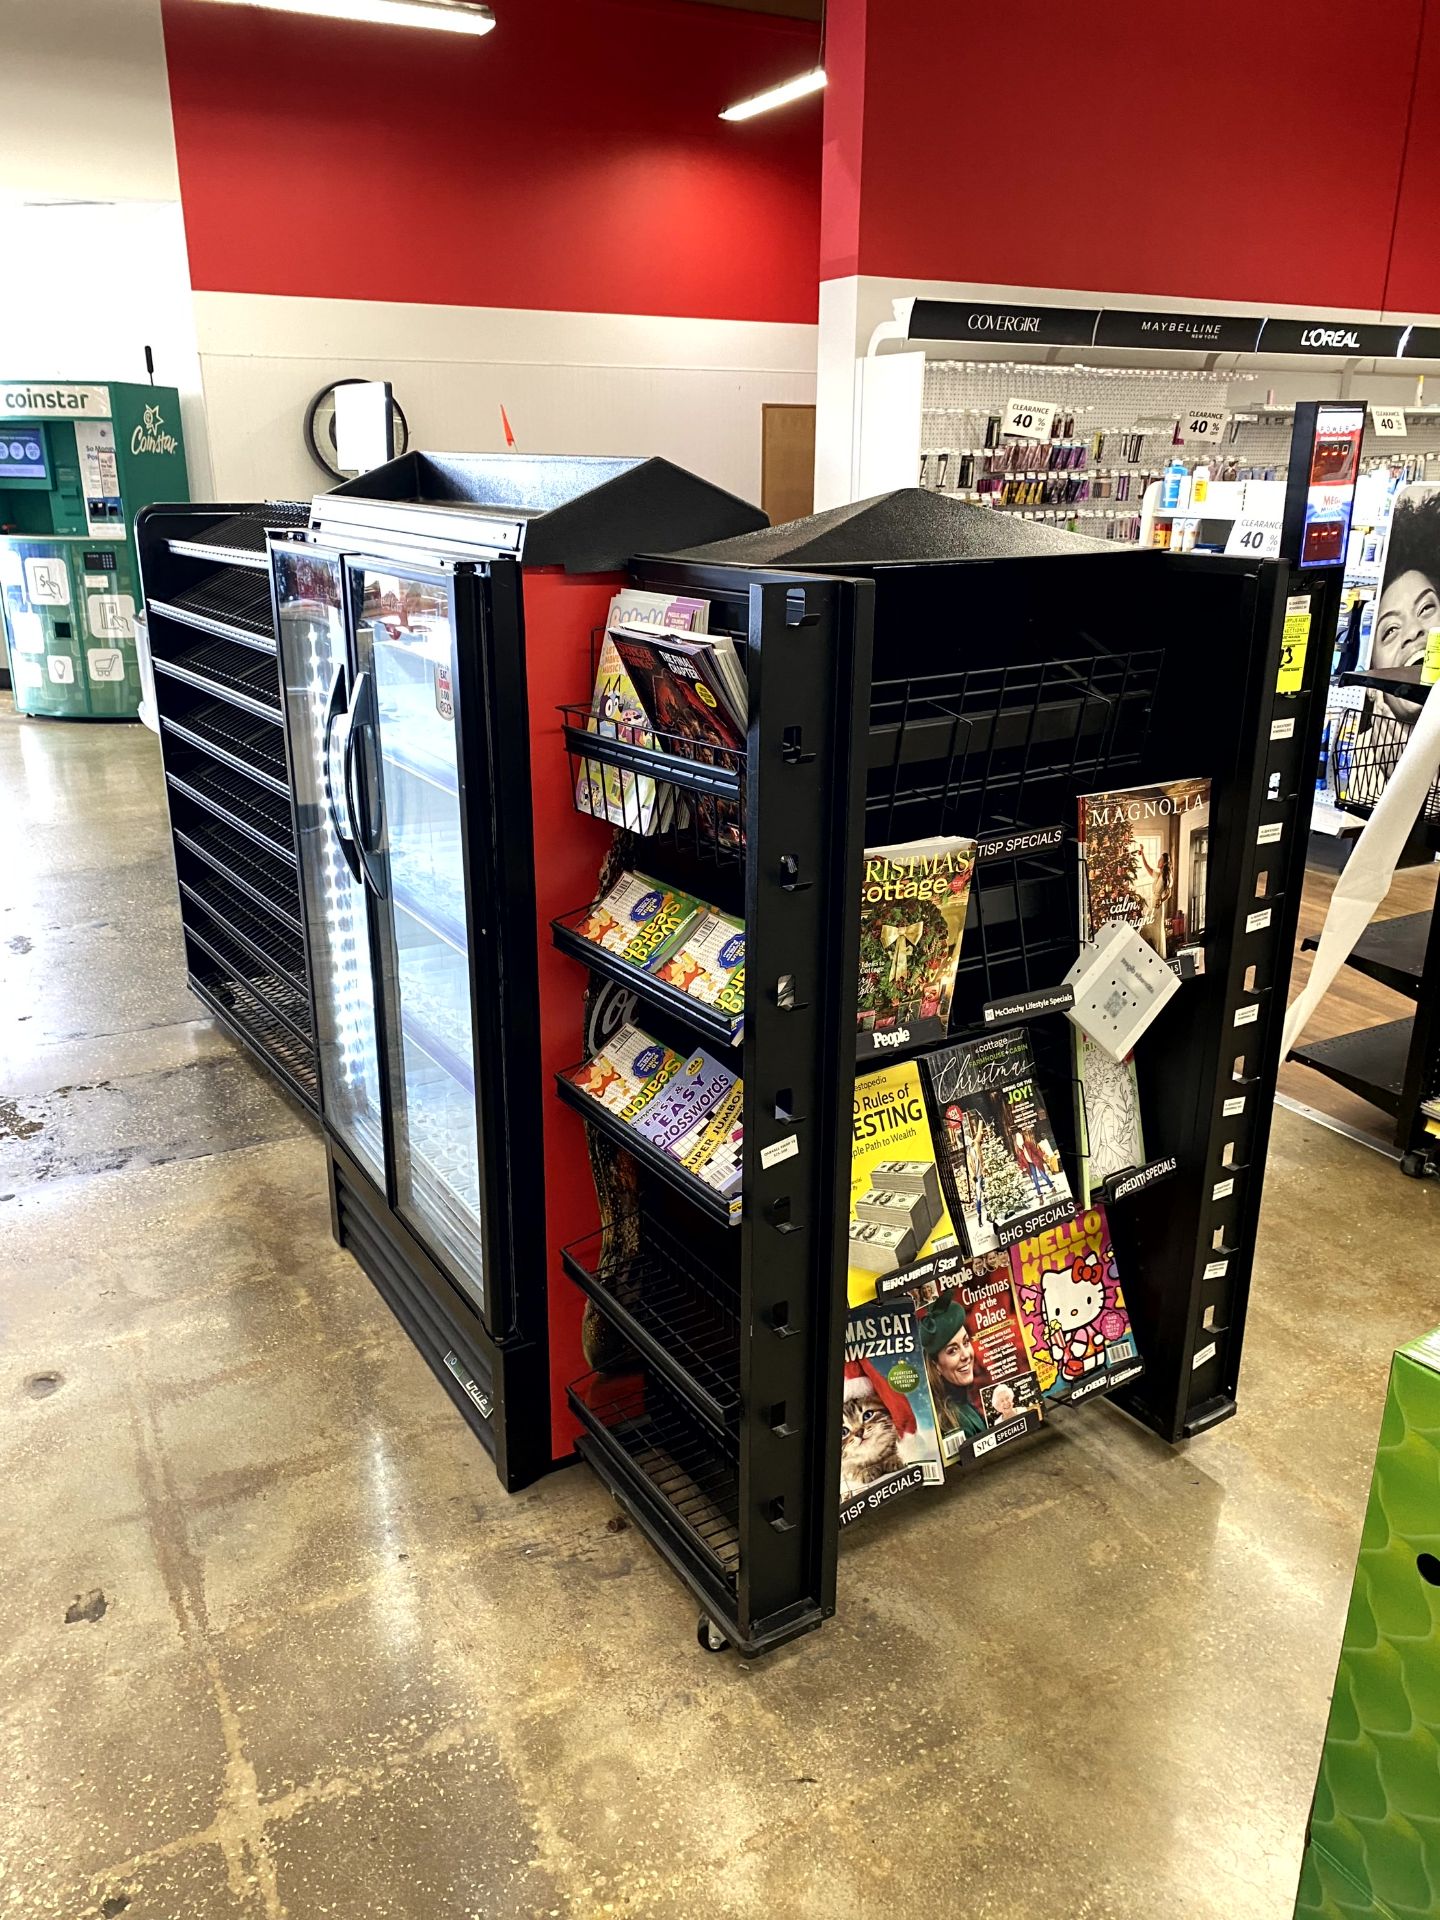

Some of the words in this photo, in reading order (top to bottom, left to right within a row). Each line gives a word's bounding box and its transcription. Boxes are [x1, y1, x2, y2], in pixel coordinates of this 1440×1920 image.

[968, 313, 1042, 333] COVERGIRL
[1141, 320, 1222, 335] MAYBELLINE
[1300, 327, 1361, 349] L'ORÉAL
[6, 390, 89, 409] coinstar
[1012, 403, 1049, 414] CLEARANCE
[1013, 413, 1033, 429] 40
[1038, 417, 1046, 427] %
[1190, 410, 1224, 420] CLEARANCE
[1190, 419, 1208, 434] 40
[1212, 422, 1220, 431] %
[1381, 418, 1394, 430] 40
[131, 424, 179, 456] Coinstar
[1240, 531, 1264, 549] 40
[1269, 534, 1279, 546] %
[1092, 794, 1205, 827] MAGNOLIA
[977, 842, 1004, 858] TISP
[1005, 830, 1063, 852] SPECIALS
[865, 850, 971, 883] RISTMAS
[1110, 893, 1140, 914] calm,
[620, 900, 682, 961] Search
[637, 916, 683, 962] Word
[1025, 999, 1049, 1011] Lifestyle
[1049, 993, 1073, 1006] Specials
[873, 1027, 910, 1048] People
[978, 1037, 1008, 1053] cottage
[618, 1058, 682, 1122] Search
[932, 1054, 1036, 1104] Christmas
[644, 1095, 675, 1127] FAST
[675, 1084, 684, 1095] &
[658, 1073, 705, 1128] EASY
[862, 1091, 895, 1112] Rules
[897, 1082, 910, 1100] of
[1008, 1085, 1033, 1105] JOY!
[653, 1074, 729, 1148] Crosswords
[712, 1090, 743, 1136] JUMBO!
[853, 1098, 923, 1142] ESTING
[852, 1146, 865, 1161] ple
[865, 1139, 882, 1153] Path
[882, 1137, 891, 1147] to
[890, 1127, 917, 1143] Wealth
[1145, 1157, 1177, 1181] SPECIALS
[1000, 1223, 1024, 1246] BHG
[1025, 1201, 1076, 1235] SPECIALS
[1018, 1210, 1103, 1263] HELLO
[938, 1267, 973, 1292] People
[962, 1278, 1010, 1306] Christmas
[979, 1300, 987, 1310] at
[986, 1296, 998, 1308] the
[880, 1313, 912, 1337] CAT
[975, 1308, 1007, 1330] Palace
[976, 1436, 995, 1453] SPC
[996, 1422, 1024, 1442] SPECIALS
[840, 1500, 866, 1525] TISP
[868, 1469, 922, 1508] SPECIALS
